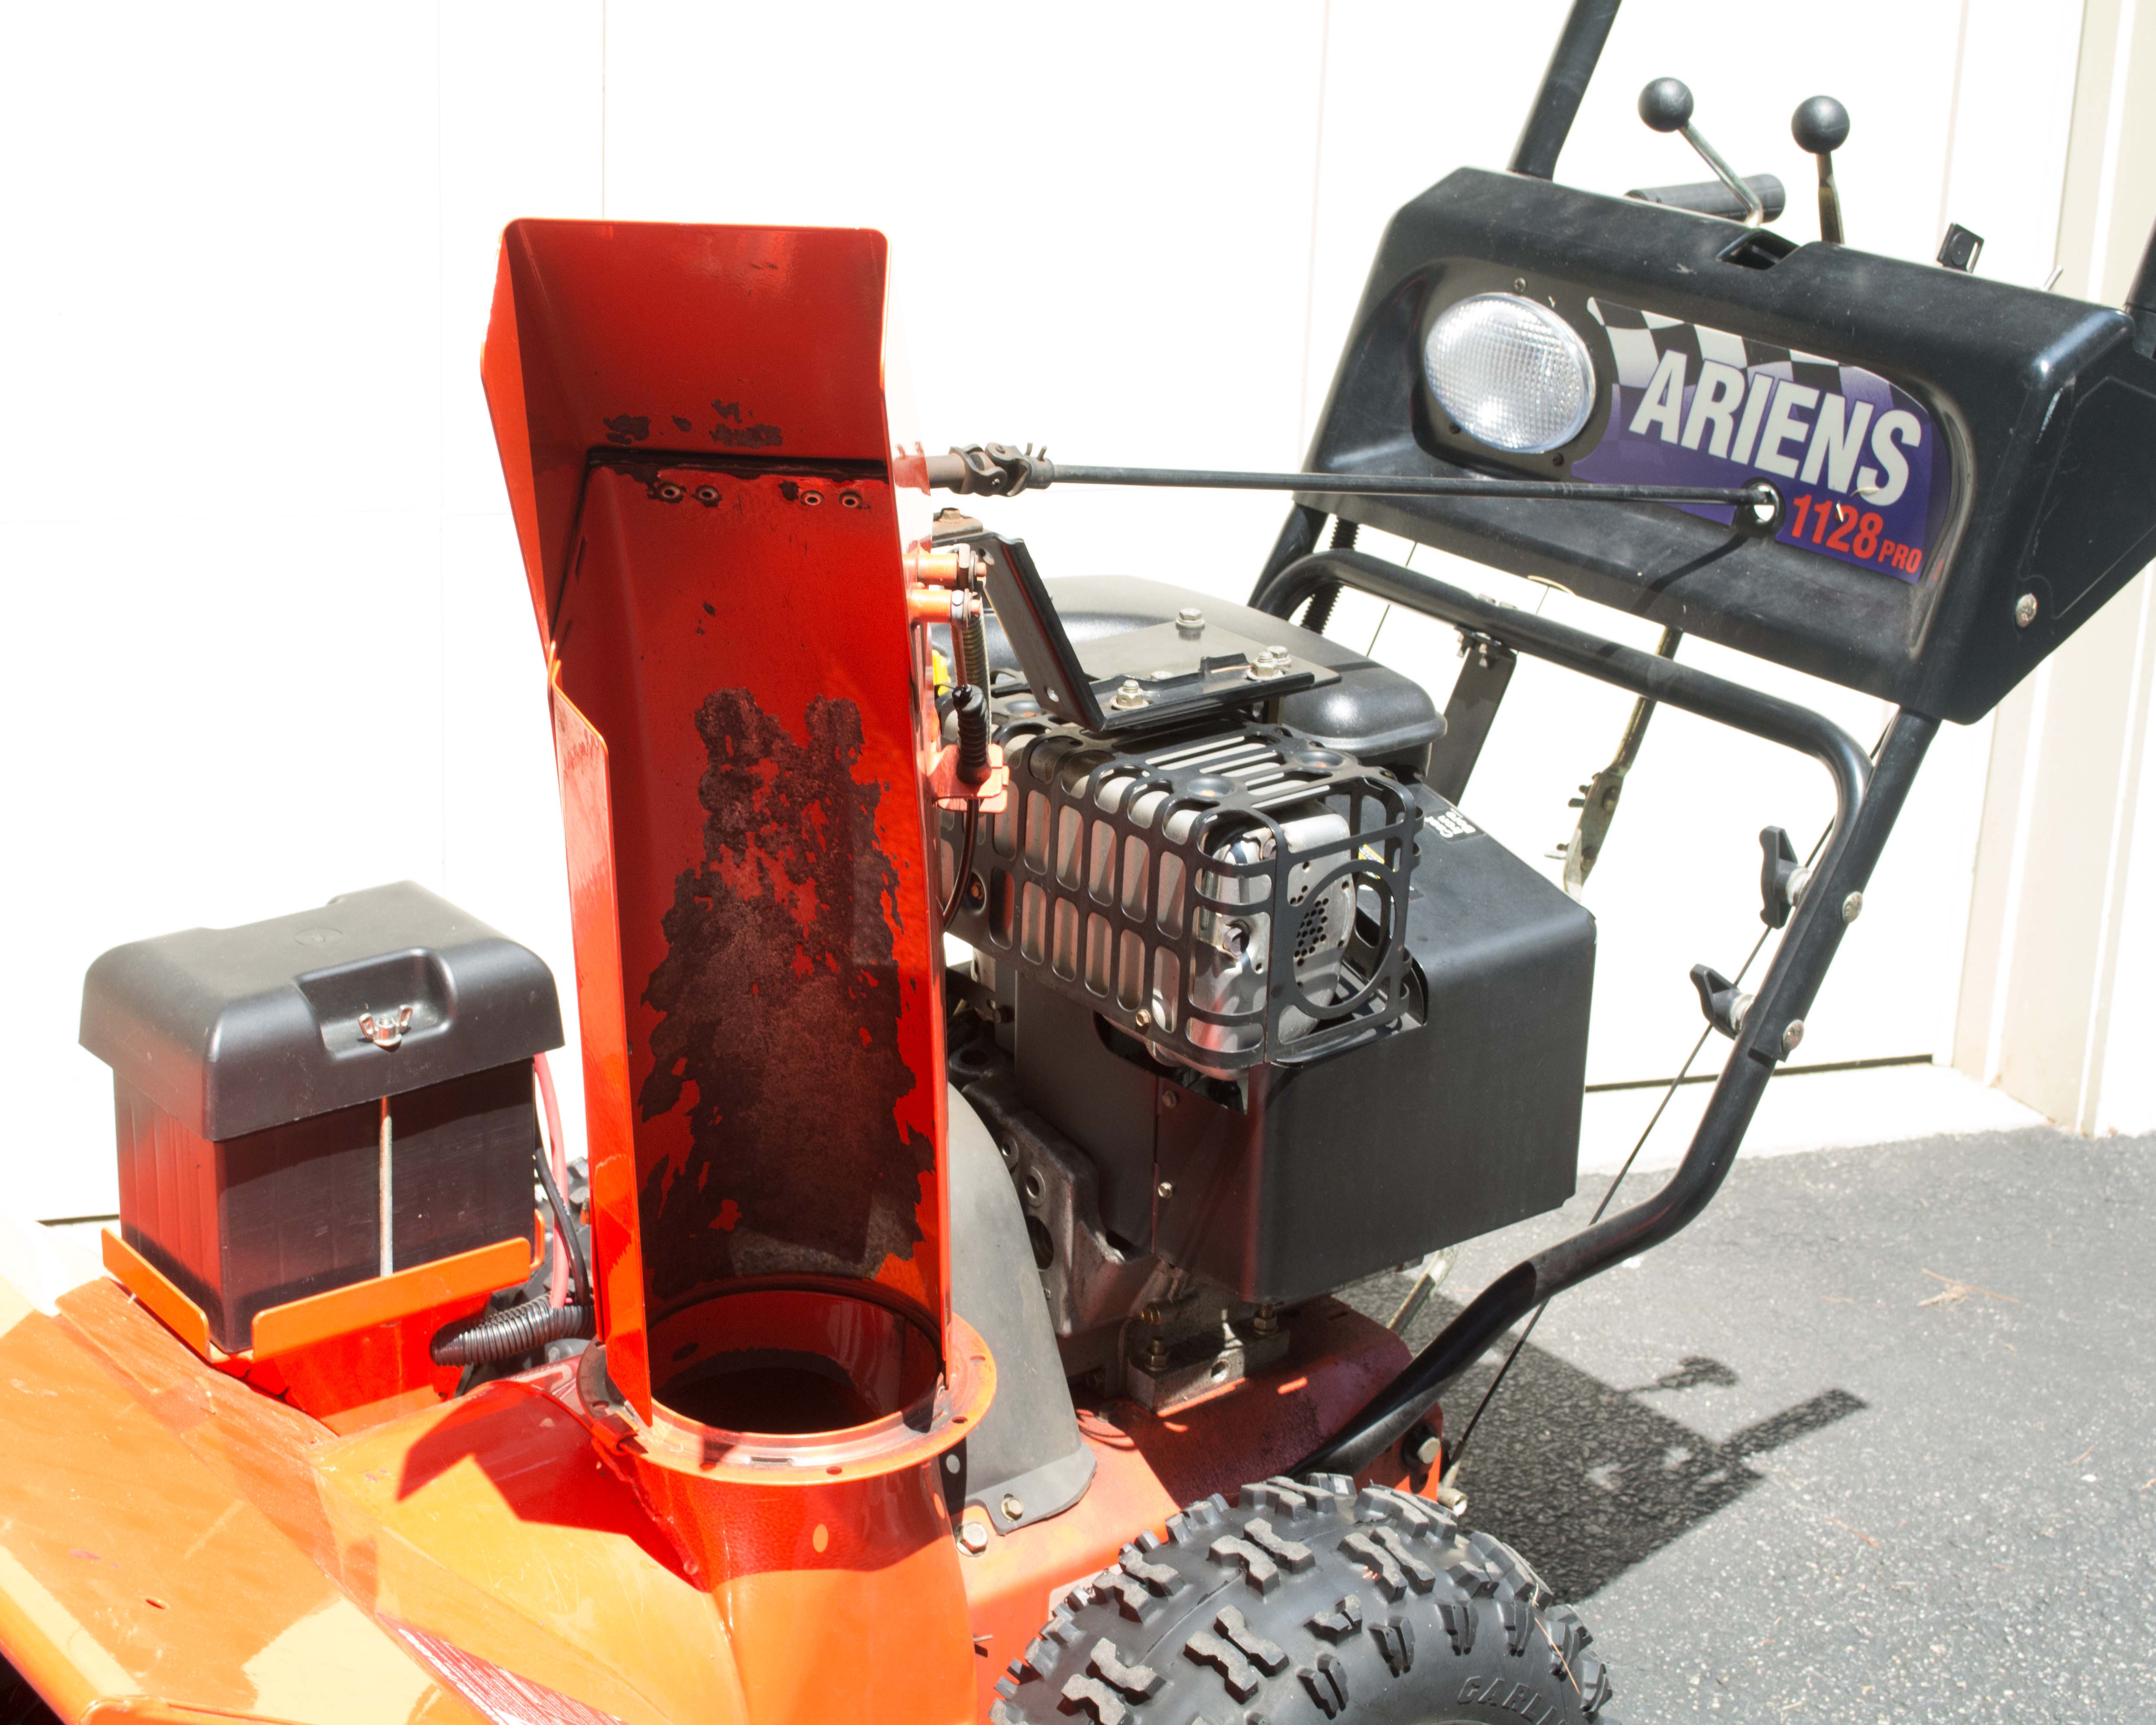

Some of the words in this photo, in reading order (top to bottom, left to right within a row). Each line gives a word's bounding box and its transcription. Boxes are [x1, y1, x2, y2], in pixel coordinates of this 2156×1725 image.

[1629, 349, 1921, 506] ARIENS
[1791, 494, 1884, 559] 1128
[1877, 539, 1922, 573] PRO
[1457, 1675, 1567, 1725] CARLI
